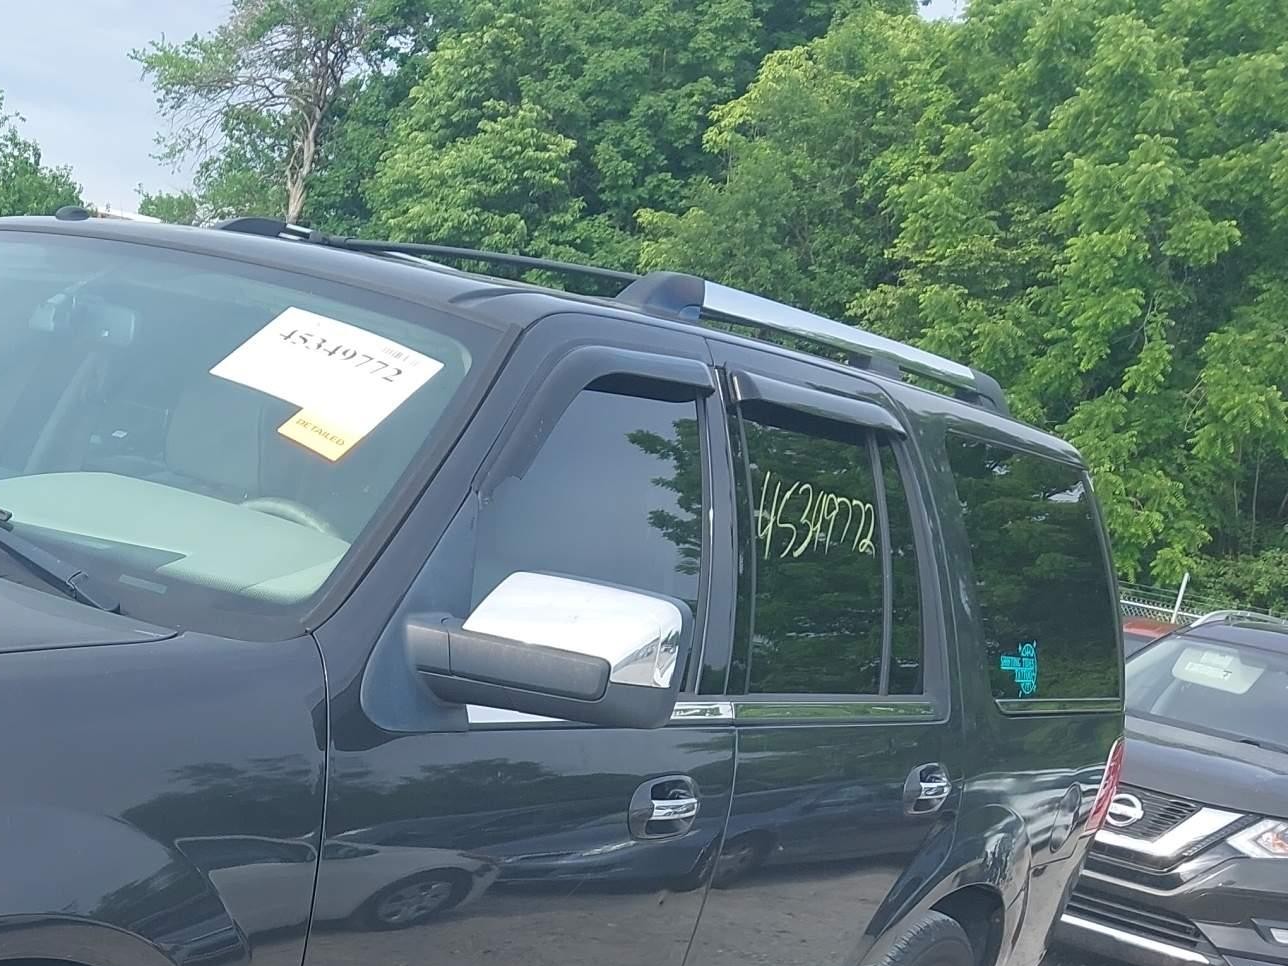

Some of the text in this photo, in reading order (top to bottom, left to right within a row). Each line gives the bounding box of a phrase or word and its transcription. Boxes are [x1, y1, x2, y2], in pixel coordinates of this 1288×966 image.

[279, 329, 403, 382] 45349772
[295, 418, 346, 447] DETAILED
[757, 470, 876, 560] 45349772
